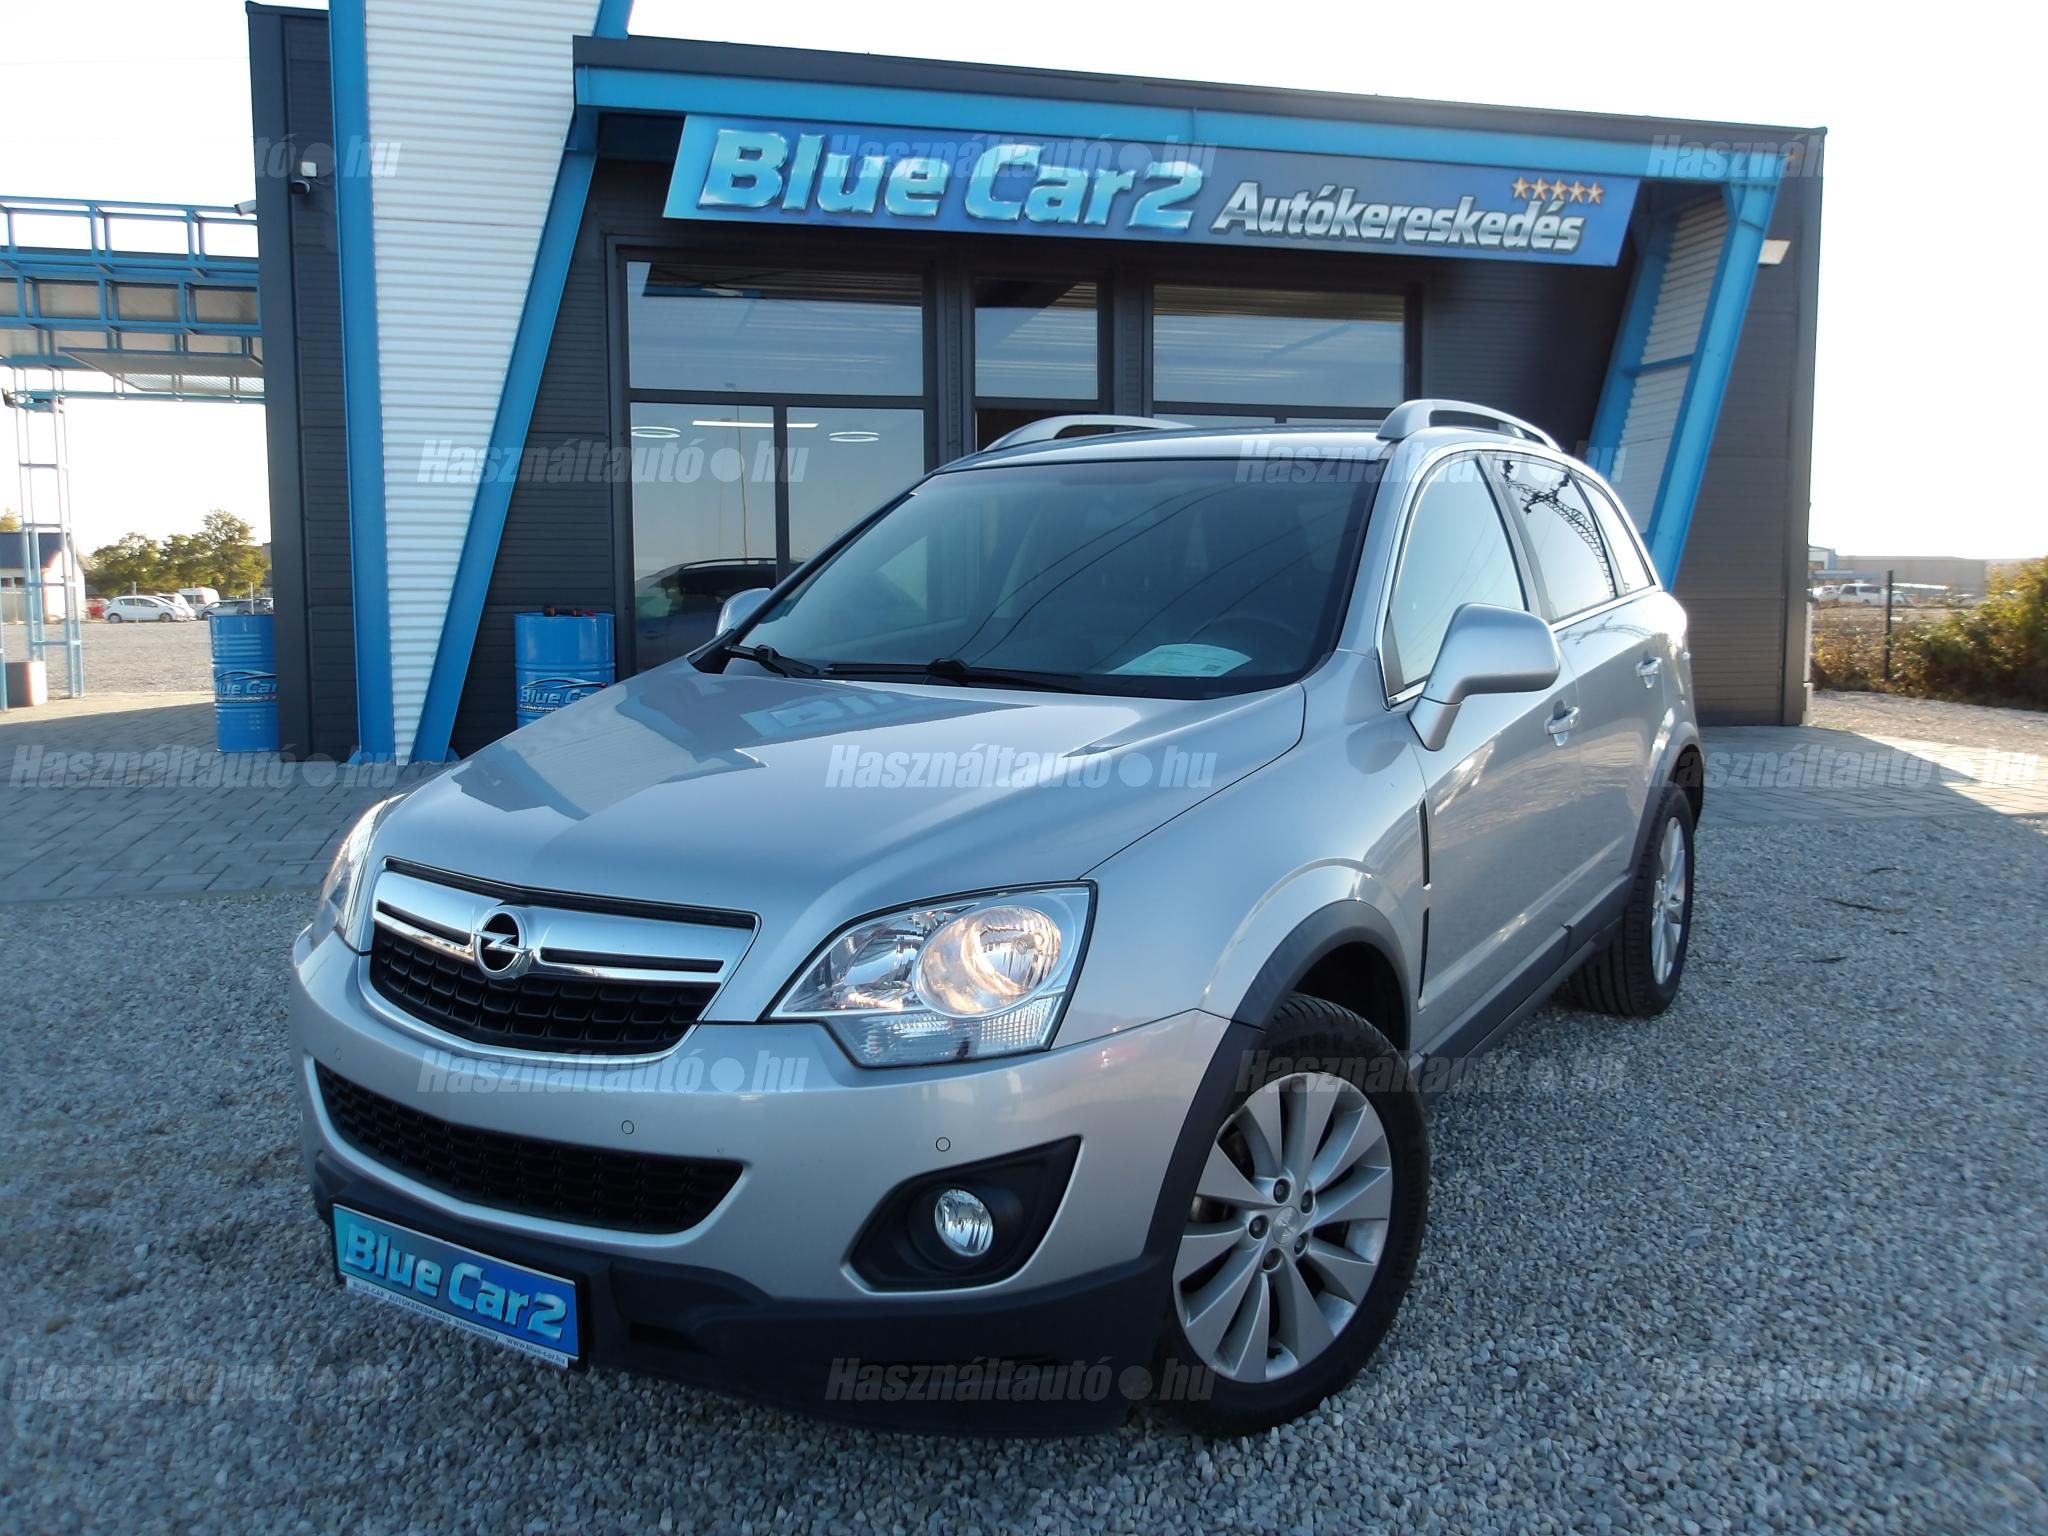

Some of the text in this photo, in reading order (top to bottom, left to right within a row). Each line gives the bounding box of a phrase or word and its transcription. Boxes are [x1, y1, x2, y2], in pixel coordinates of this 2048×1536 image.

[697, 128, 1586, 252] Blue Car2 Autókereskedés
[520, 689, 562, 704] Blue
[345, 1223, 567, 1341] Blue Car2
